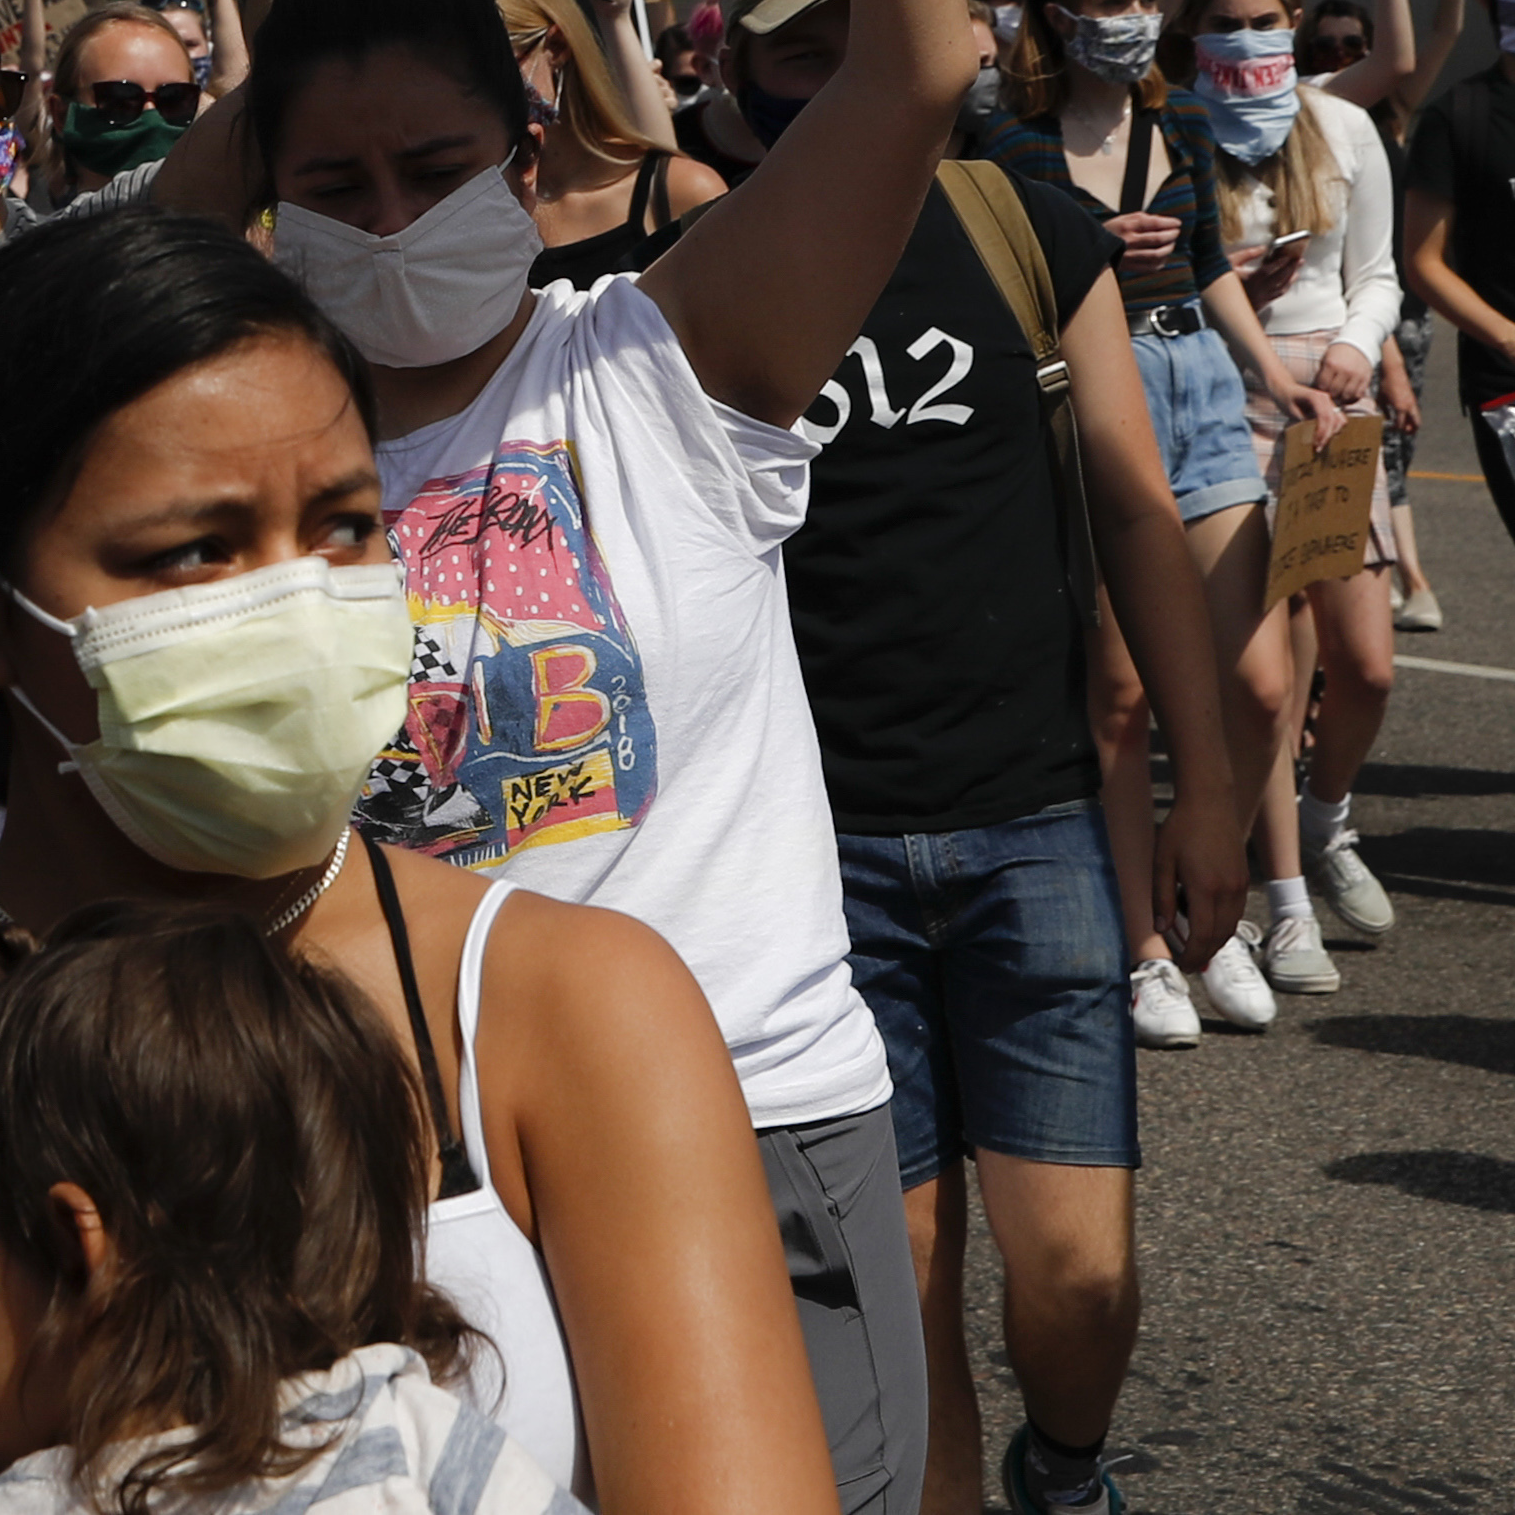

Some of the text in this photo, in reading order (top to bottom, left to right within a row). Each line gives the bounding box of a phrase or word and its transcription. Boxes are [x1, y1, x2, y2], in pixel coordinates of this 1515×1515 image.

[610, 674, 638, 772] 2018
[509, 754, 584, 804] NEW
[509, 778, 596, 832] YORK
